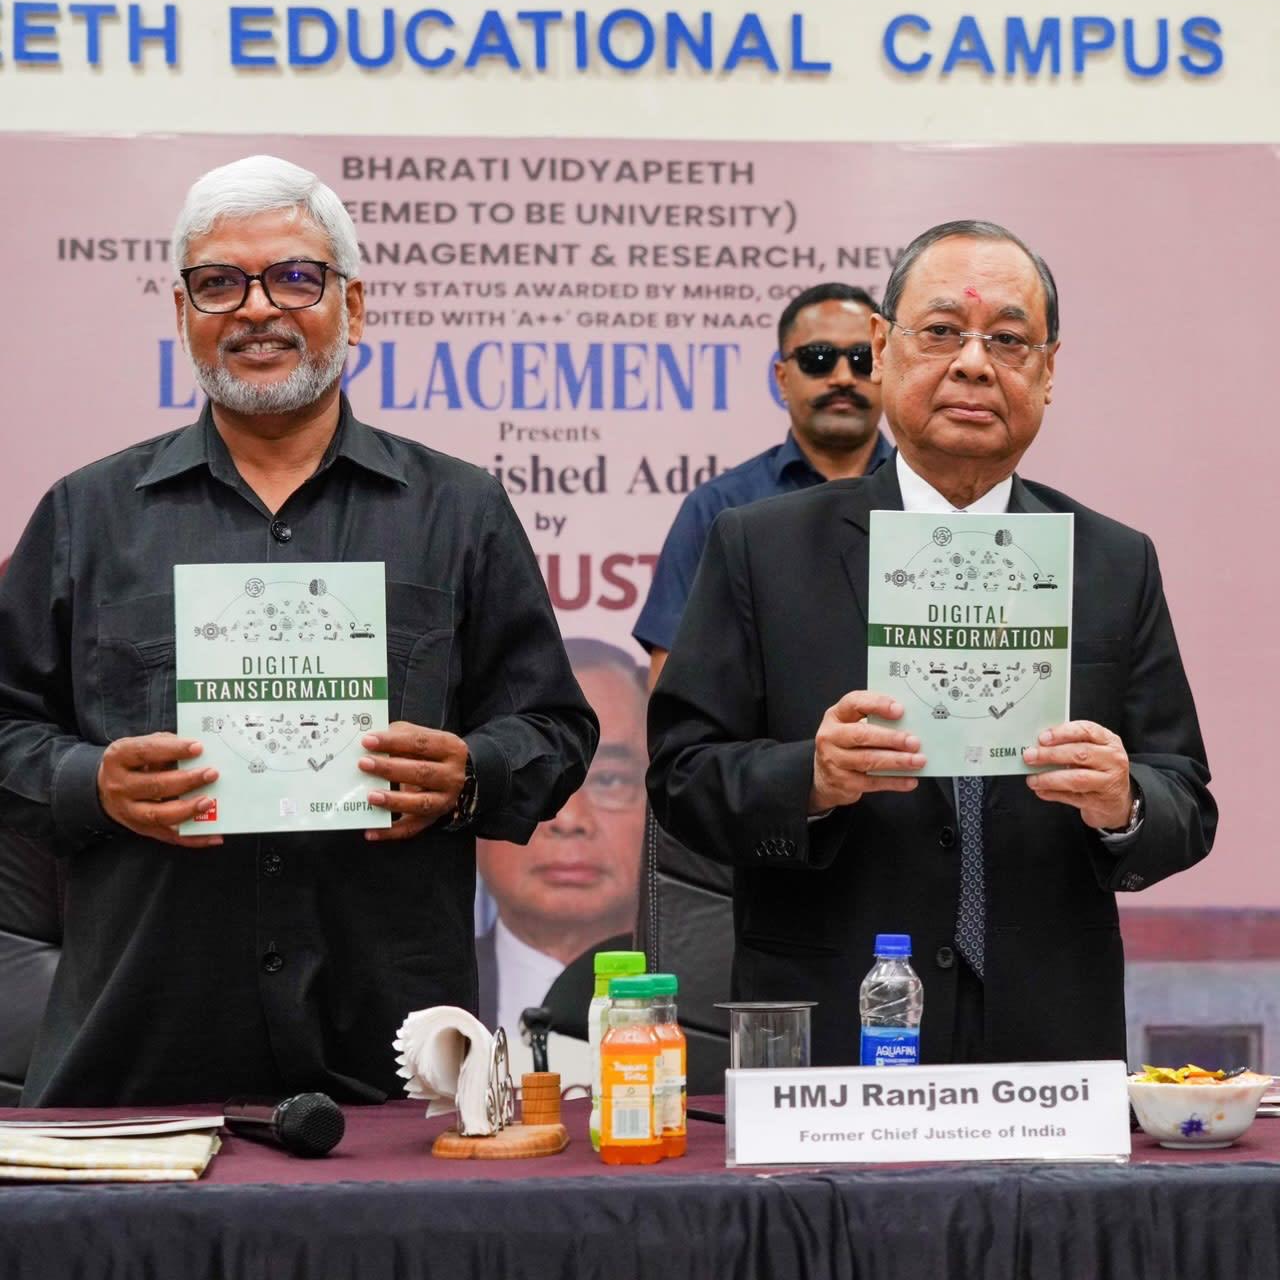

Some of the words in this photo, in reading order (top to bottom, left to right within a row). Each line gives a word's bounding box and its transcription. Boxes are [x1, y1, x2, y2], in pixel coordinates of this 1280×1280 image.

[229, 6, 832, 74] EDUCATIONAL
[882, 13, 1225, 78] CAMPUS
[341, 156, 510, 181] BHARATI
[521, 157, 755, 185] VIDYAPEETH
[468, 202, 515, 225] TO
[525, 202, 566, 225] BE
[576, 199, 798, 234] UNIVERSITY)
[590, 243, 615, 267] &
[628, 245, 826, 273] RESEARCH,
[414, 282, 506, 298] STATUS
[515, 282, 639, 300] AWARDED
[646, 284, 677, 300] BY
[683, 285, 761, 302] MHRD,
[442, 311, 505, 327] WITH
[576, 311, 659, 329] GRADE
[665, 313, 696, 328] BY
[703, 313, 772, 329] NAAC
[499, 421, 600, 442] Presents
[535, 512, 567, 537] by
[928, 604, 1008, 624] DIGITAL
[883, 626, 1055, 648] TRANSFORMATION
[242, 655, 325, 676] DIGITAL
[194, 679, 374, 700] TRANSFORMATION
[989, 747, 1017, 758] SEEMA
[343, 800, 373, 812] GUPTA
[876, 1045, 917, 1057] AQUAFINA
[773, 1084, 848, 1109] HMJ
[862, 1082, 979, 1111] Ranjan
[991, 1078, 1090, 1109] Gogoi
[800, 1129, 865, 1142] Former
[871, 1127, 919, 1142] Chief
[924, 1126, 992, 1140] Justice
[998, 1125, 1016, 1139] of
[1021, 1124, 1067, 1138] India
